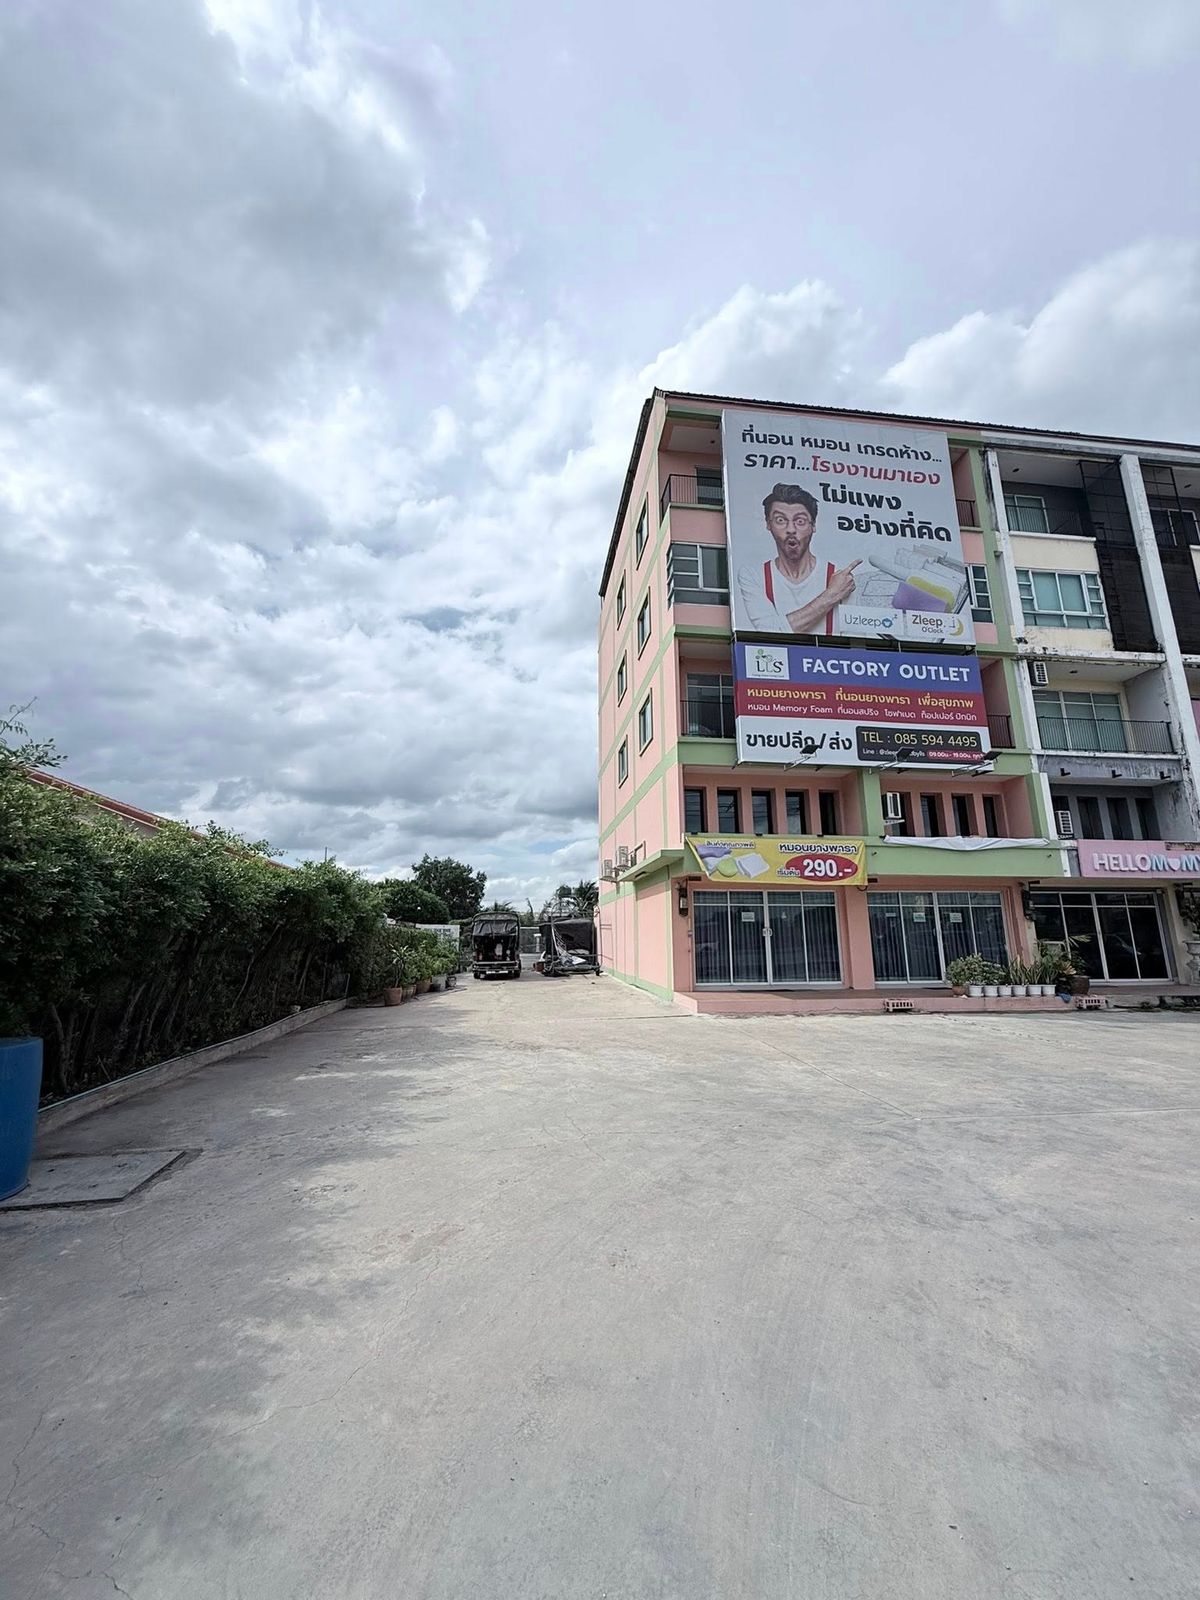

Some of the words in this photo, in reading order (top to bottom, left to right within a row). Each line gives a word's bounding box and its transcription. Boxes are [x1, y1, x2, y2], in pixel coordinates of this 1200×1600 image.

[741, 424, 794, 446] ที่นอน
[800, 436, 850, 452] หมอน
[857, 442, 943, 463] เกรดห้าง...
[819, 482, 903, 510] ไม่แพง
[837, 511, 953, 542] อย่างที่คิด
[802, 658, 891, 677] FACTORY
[899, 664, 970, 682] OUTLET
[747, 688, 826, 700] หมอนยางพารา
[835, 688, 911, 705] ที่นอนยางพารา
[918, 692, 974, 710] เพื่อสุขภาพ
[747, 703, 770, 711] หมอน
[772, 703, 807, 714] Memory
[810, 705, 833, 714] Foam
[837, 704, 879, 717] ที่นอนสปริง
[861, 731, 883, 743] TEL
[894, 733, 918, 745] 085
[921, 734, 944, 746] 594
[947, 735, 978, 747] 4495
[778, 842, 858, 855] หมอนยางพารา
[803, 858, 853, 878] 290.-
